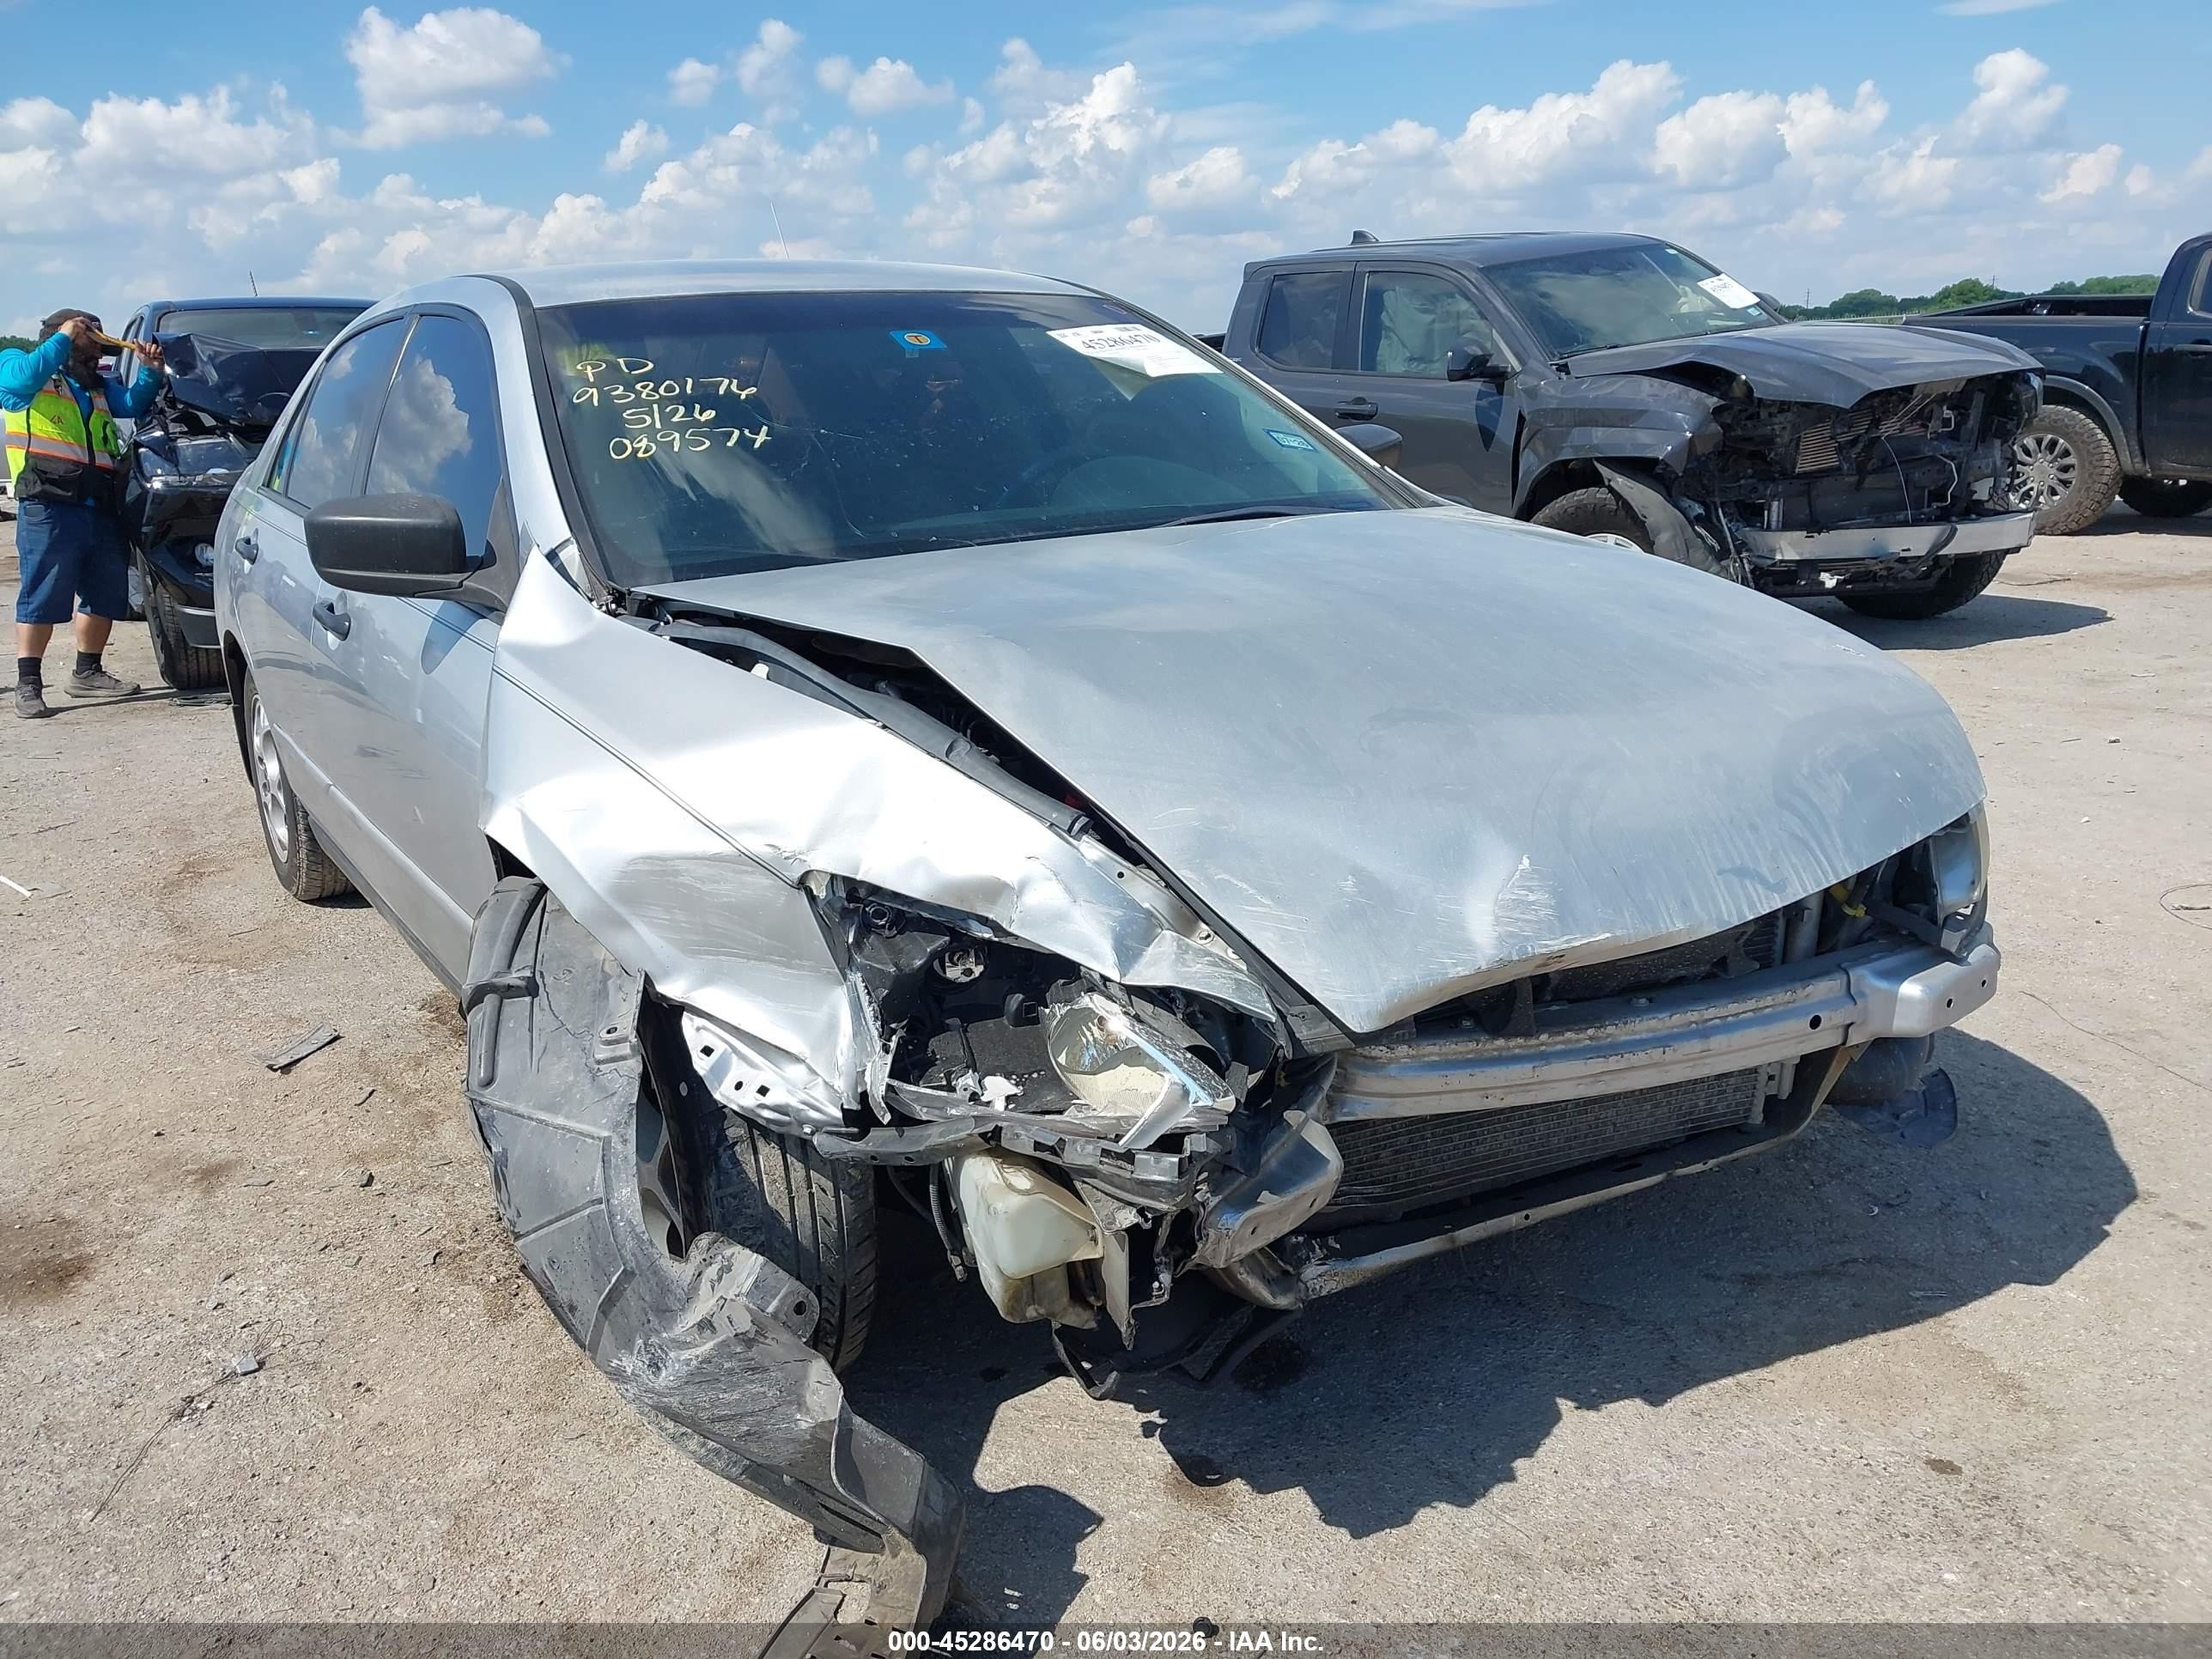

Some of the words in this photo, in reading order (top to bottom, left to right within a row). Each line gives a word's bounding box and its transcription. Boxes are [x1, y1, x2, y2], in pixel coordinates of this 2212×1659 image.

[1082, 334, 1161, 350] 45286470
[573, 377, 757, 407] 9380176
[609, 425, 772, 460] 089574
